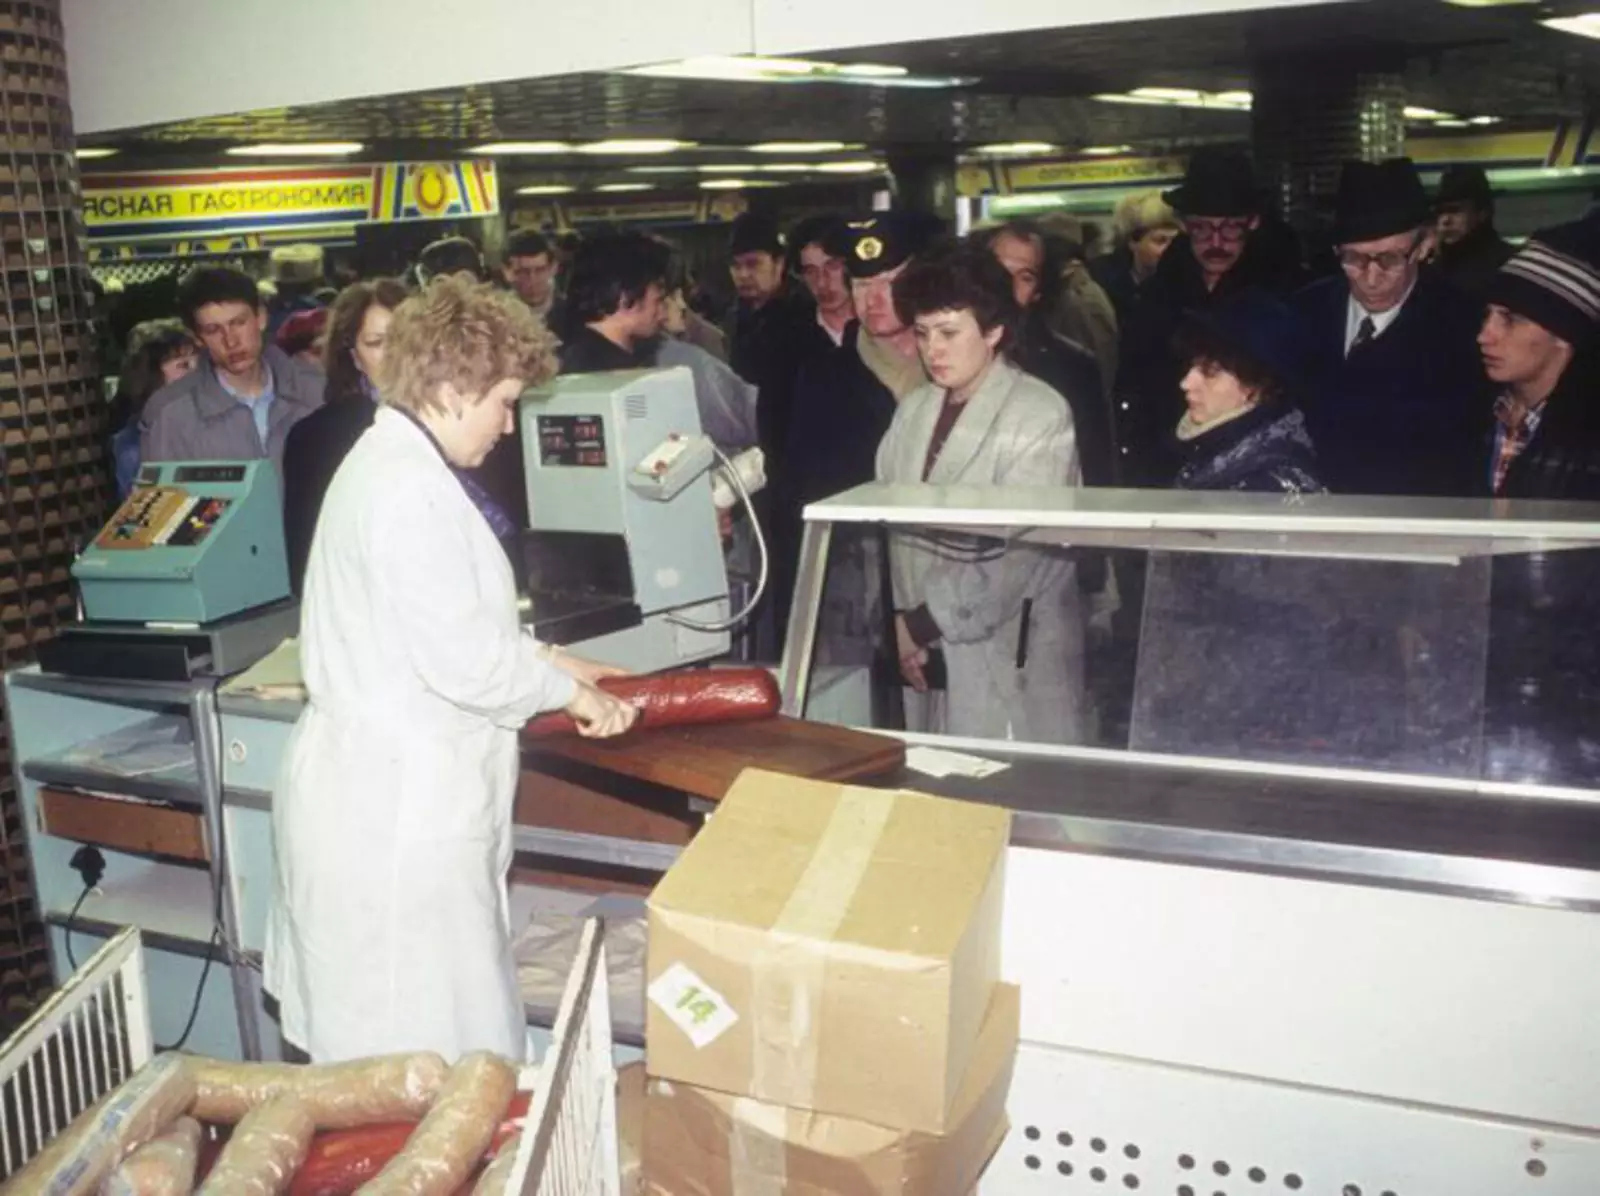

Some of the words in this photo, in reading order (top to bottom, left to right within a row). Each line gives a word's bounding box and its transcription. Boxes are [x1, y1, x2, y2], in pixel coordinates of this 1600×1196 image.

[82, 194, 173, 217] ЯСНАЯ
[189, 184, 366, 213] ГАСТРОНОМИЯ
[675, 985, 718, 1025] 14
